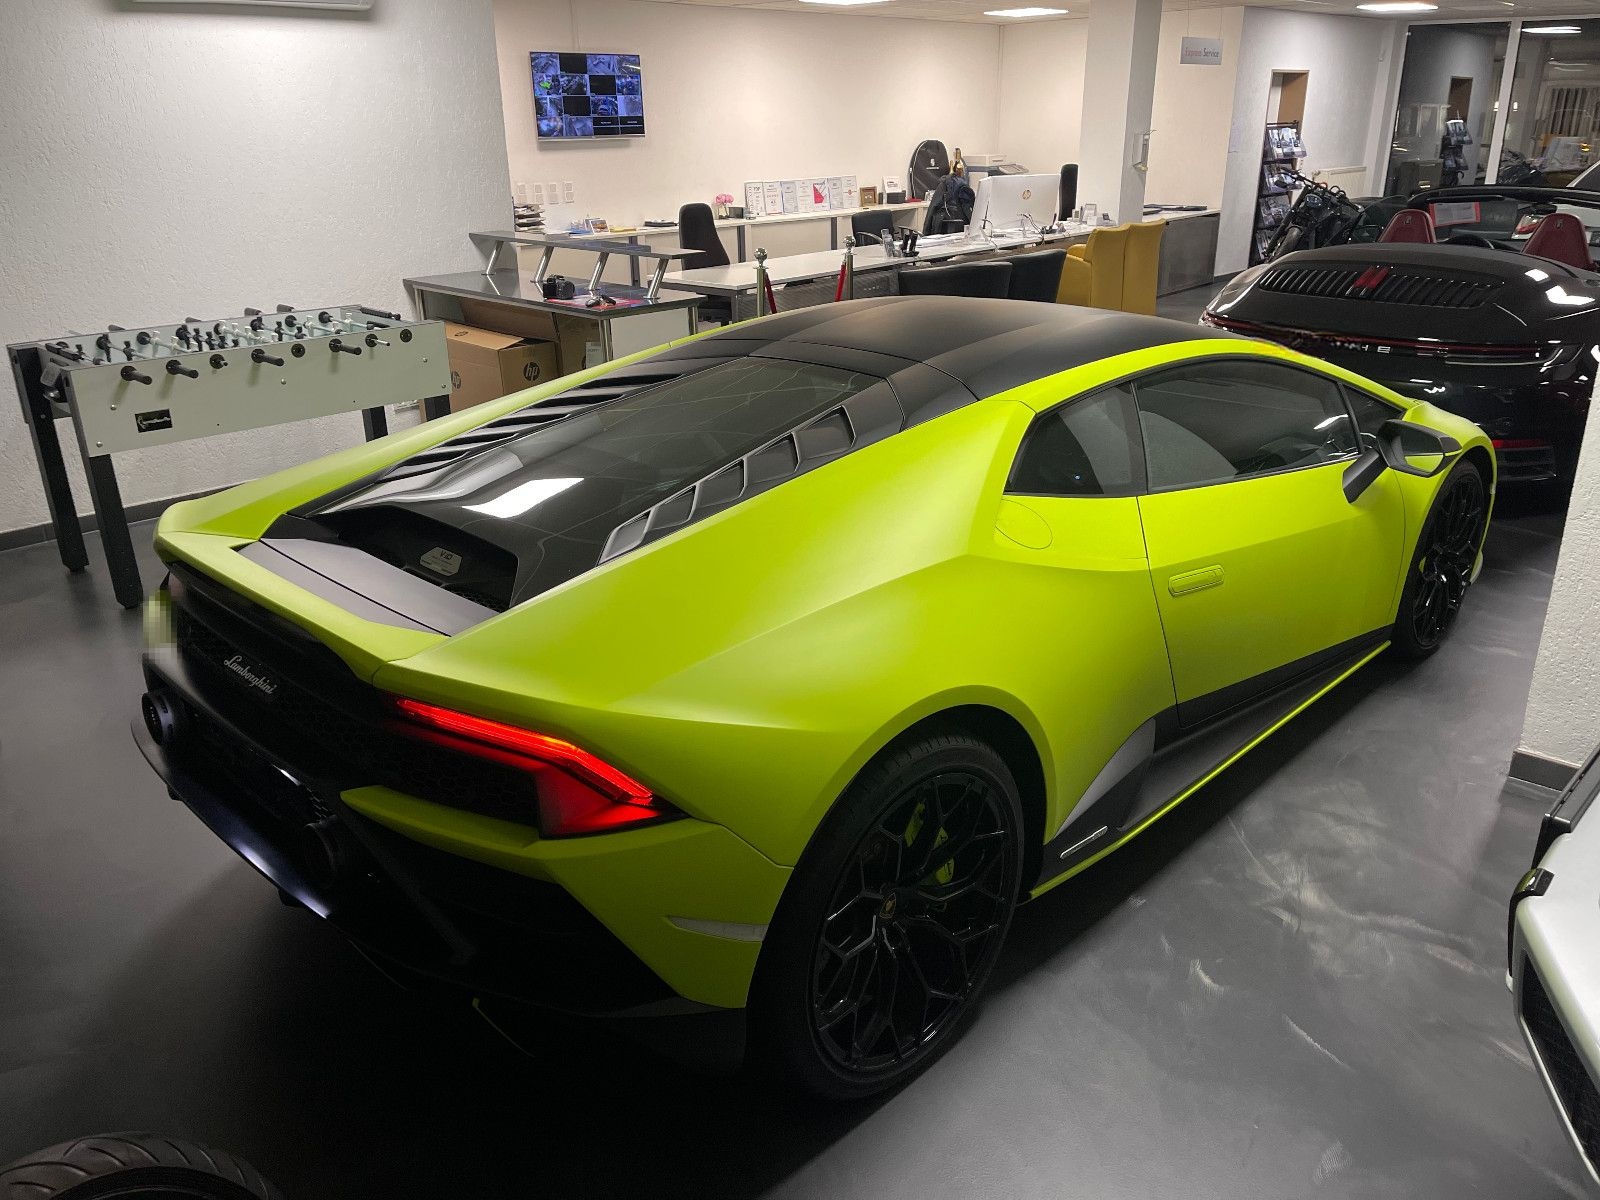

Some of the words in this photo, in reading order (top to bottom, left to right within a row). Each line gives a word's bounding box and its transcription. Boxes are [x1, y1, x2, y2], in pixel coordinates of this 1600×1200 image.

[1203, 47, 1220, 58] Service
[524, 362, 540, 381] hp
[224, 655, 277, 694] Lamborghini
